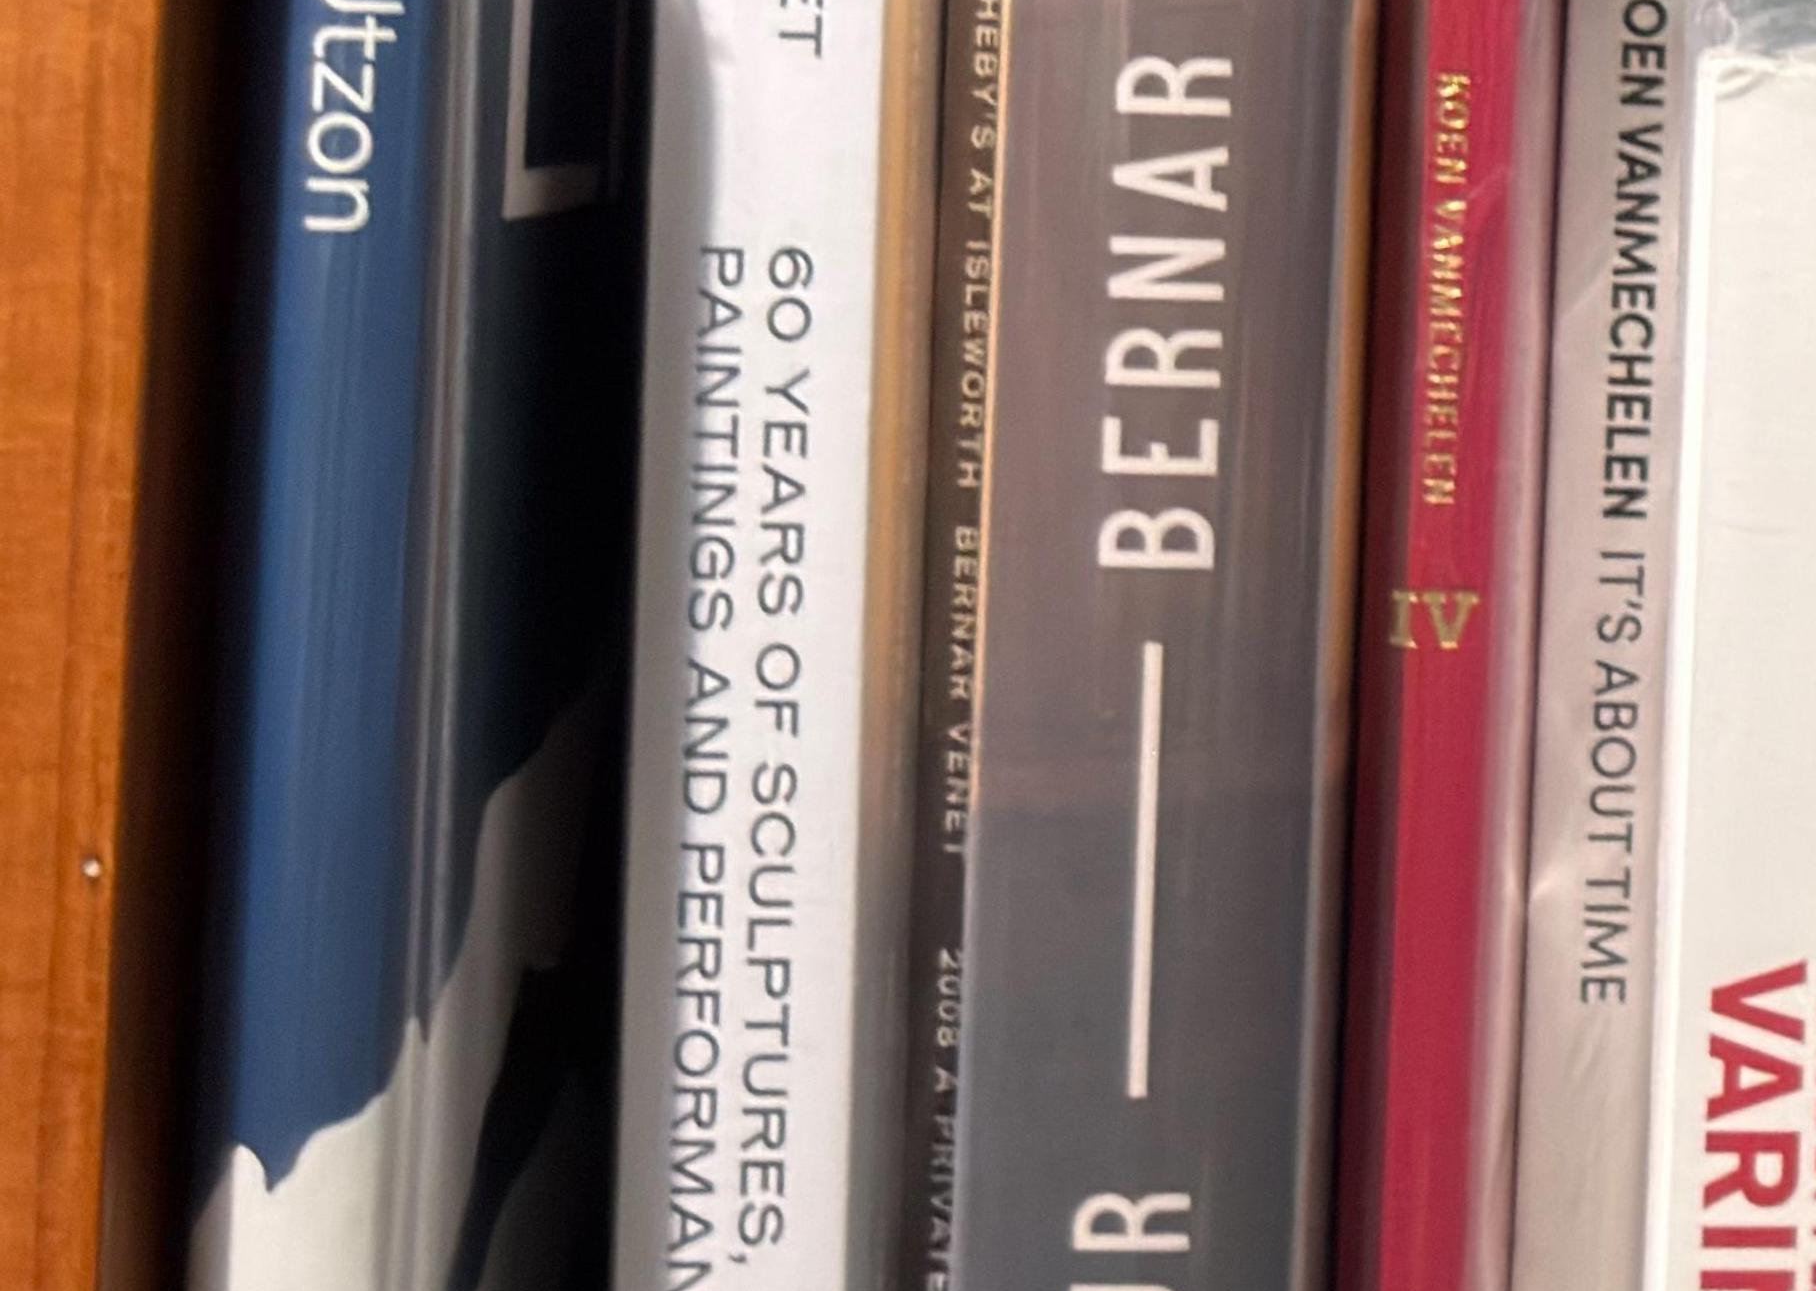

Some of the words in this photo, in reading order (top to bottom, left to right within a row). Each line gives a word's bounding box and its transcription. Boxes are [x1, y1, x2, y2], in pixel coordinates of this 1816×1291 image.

[1436, 71, 1471, 183] KOEN
[766, 246, 814, 342] 60
[1098, 55, 1232, 570] BERNAR
[1422, 199, 1466, 506] VANMECHELEN
[1601, 123, 1664, 521] VANMECHELEN
[687, 246, 744, 631] PAINTINGS
[757, 369, 810, 616] YEARS
[1390, 590, 1480, 648] IV
[1595, 549, 1646, 644] IT'S
[683, 659, 731, 816] AND
[754, 643, 800, 738] OF
[1586, 660, 1641, 854] ABOUT
[729, 762, 797, 1265] SCULPTURES,
[1578, 864, 1632, 1005] TIME
